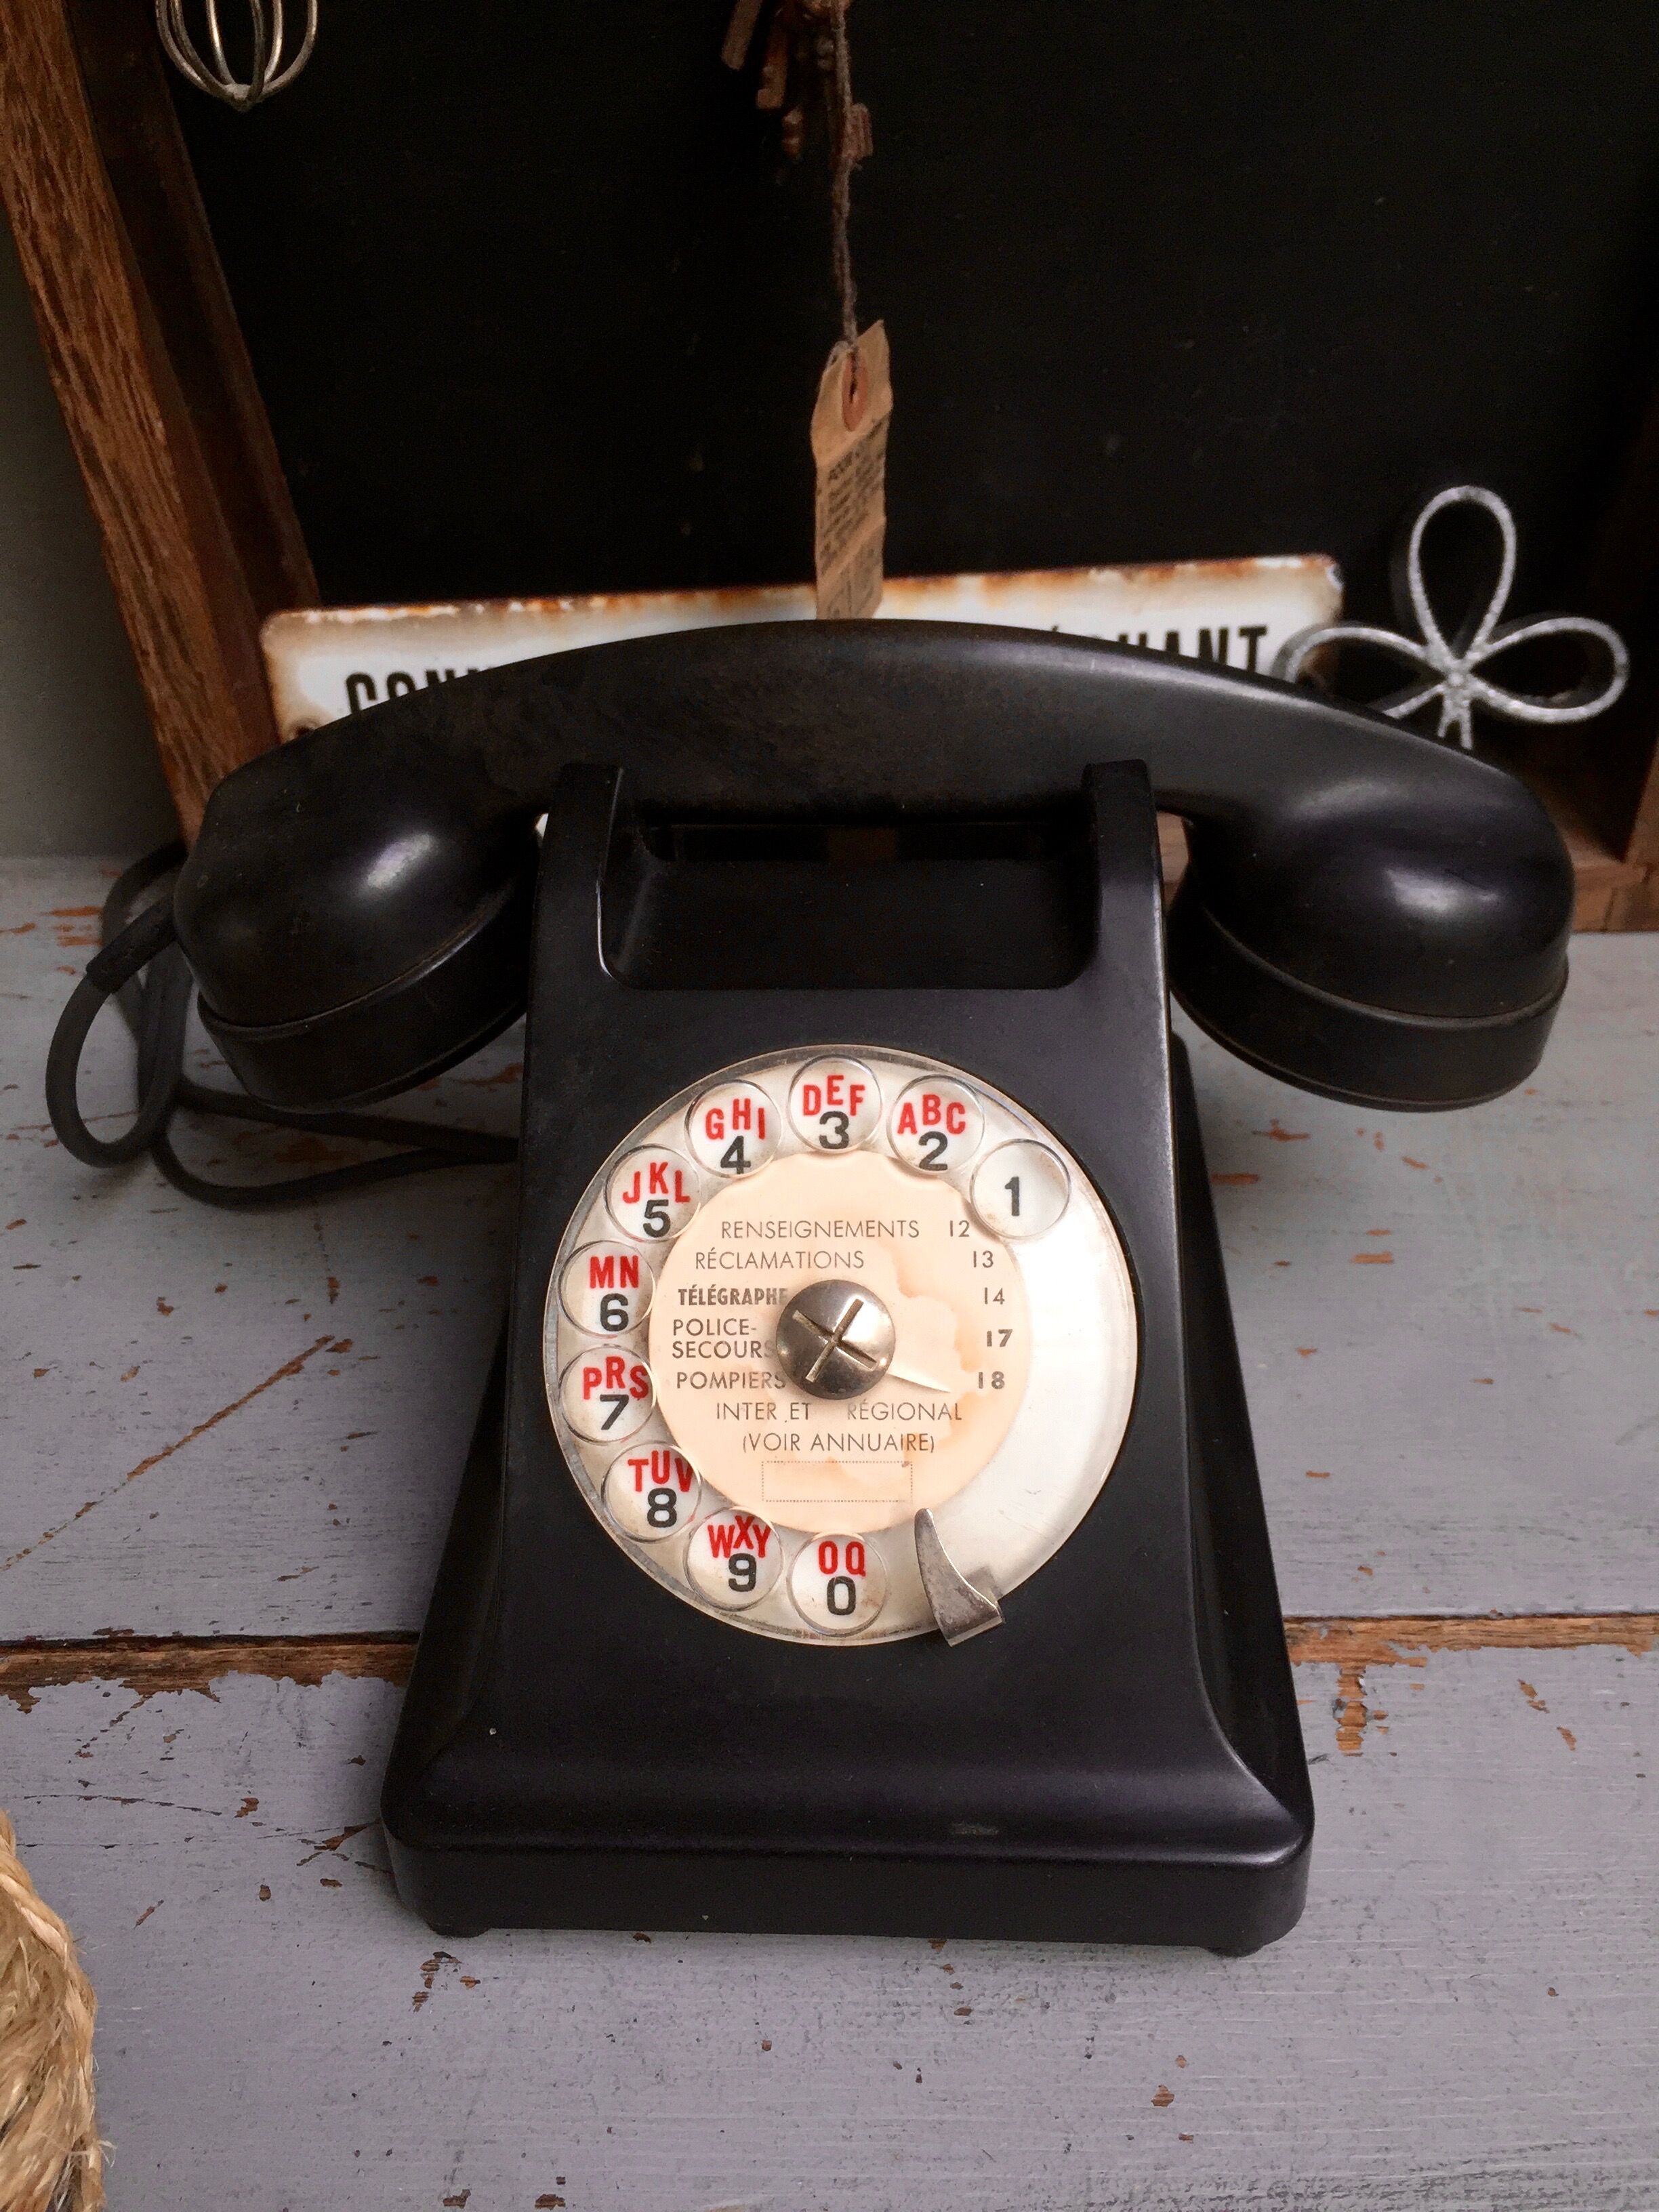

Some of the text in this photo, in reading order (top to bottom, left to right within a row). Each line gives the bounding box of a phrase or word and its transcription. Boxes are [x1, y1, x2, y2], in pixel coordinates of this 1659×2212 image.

[803, 1075, 865, 1116] DEF
[897, 1094, 966, 1134] ABC
[705, 1098, 766, 1140] GHI
[819, 1111, 849, 1149] 3
[720, 1135, 751, 1174] 4
[918, 1131, 948, 1171] 2
[622, 1162, 691, 1204] JKL
[1004, 1176, 1020, 1216] 1
[643, 1199, 671, 1237] 5
[721, 1220, 970, 1239] RENSEIGNEMENTS 12
[589, 1255, 639, 1289] MN
[695, 1247, 994, 1269] RÉCLAMATIONS 13
[600, 1293, 628, 1332] 6
[984, 1287, 1005, 1305] 14
[673, 1318, 756, 1336] POLICE-
[987, 1329, 1013, 1347] 17
[583, 1355, 649, 1400] PRS
[676, 1371, 1005, 1389] POMPIERS 18
[600, 1394, 629, 1431] 7
[716, 1399, 962, 1421] INTER ET RÉGIONAL
[743, 1433, 935, 1453] (VOIR ANNUAIRE)
[628, 1450, 694, 1492] TUV
[647, 1488, 677, 1528] 8
[708, 1515, 771, 1558] WXY
[729, 1553, 756, 1592] 9
[818, 1540, 866, 1577] OQ
[827, 1576, 856, 1616] 0
